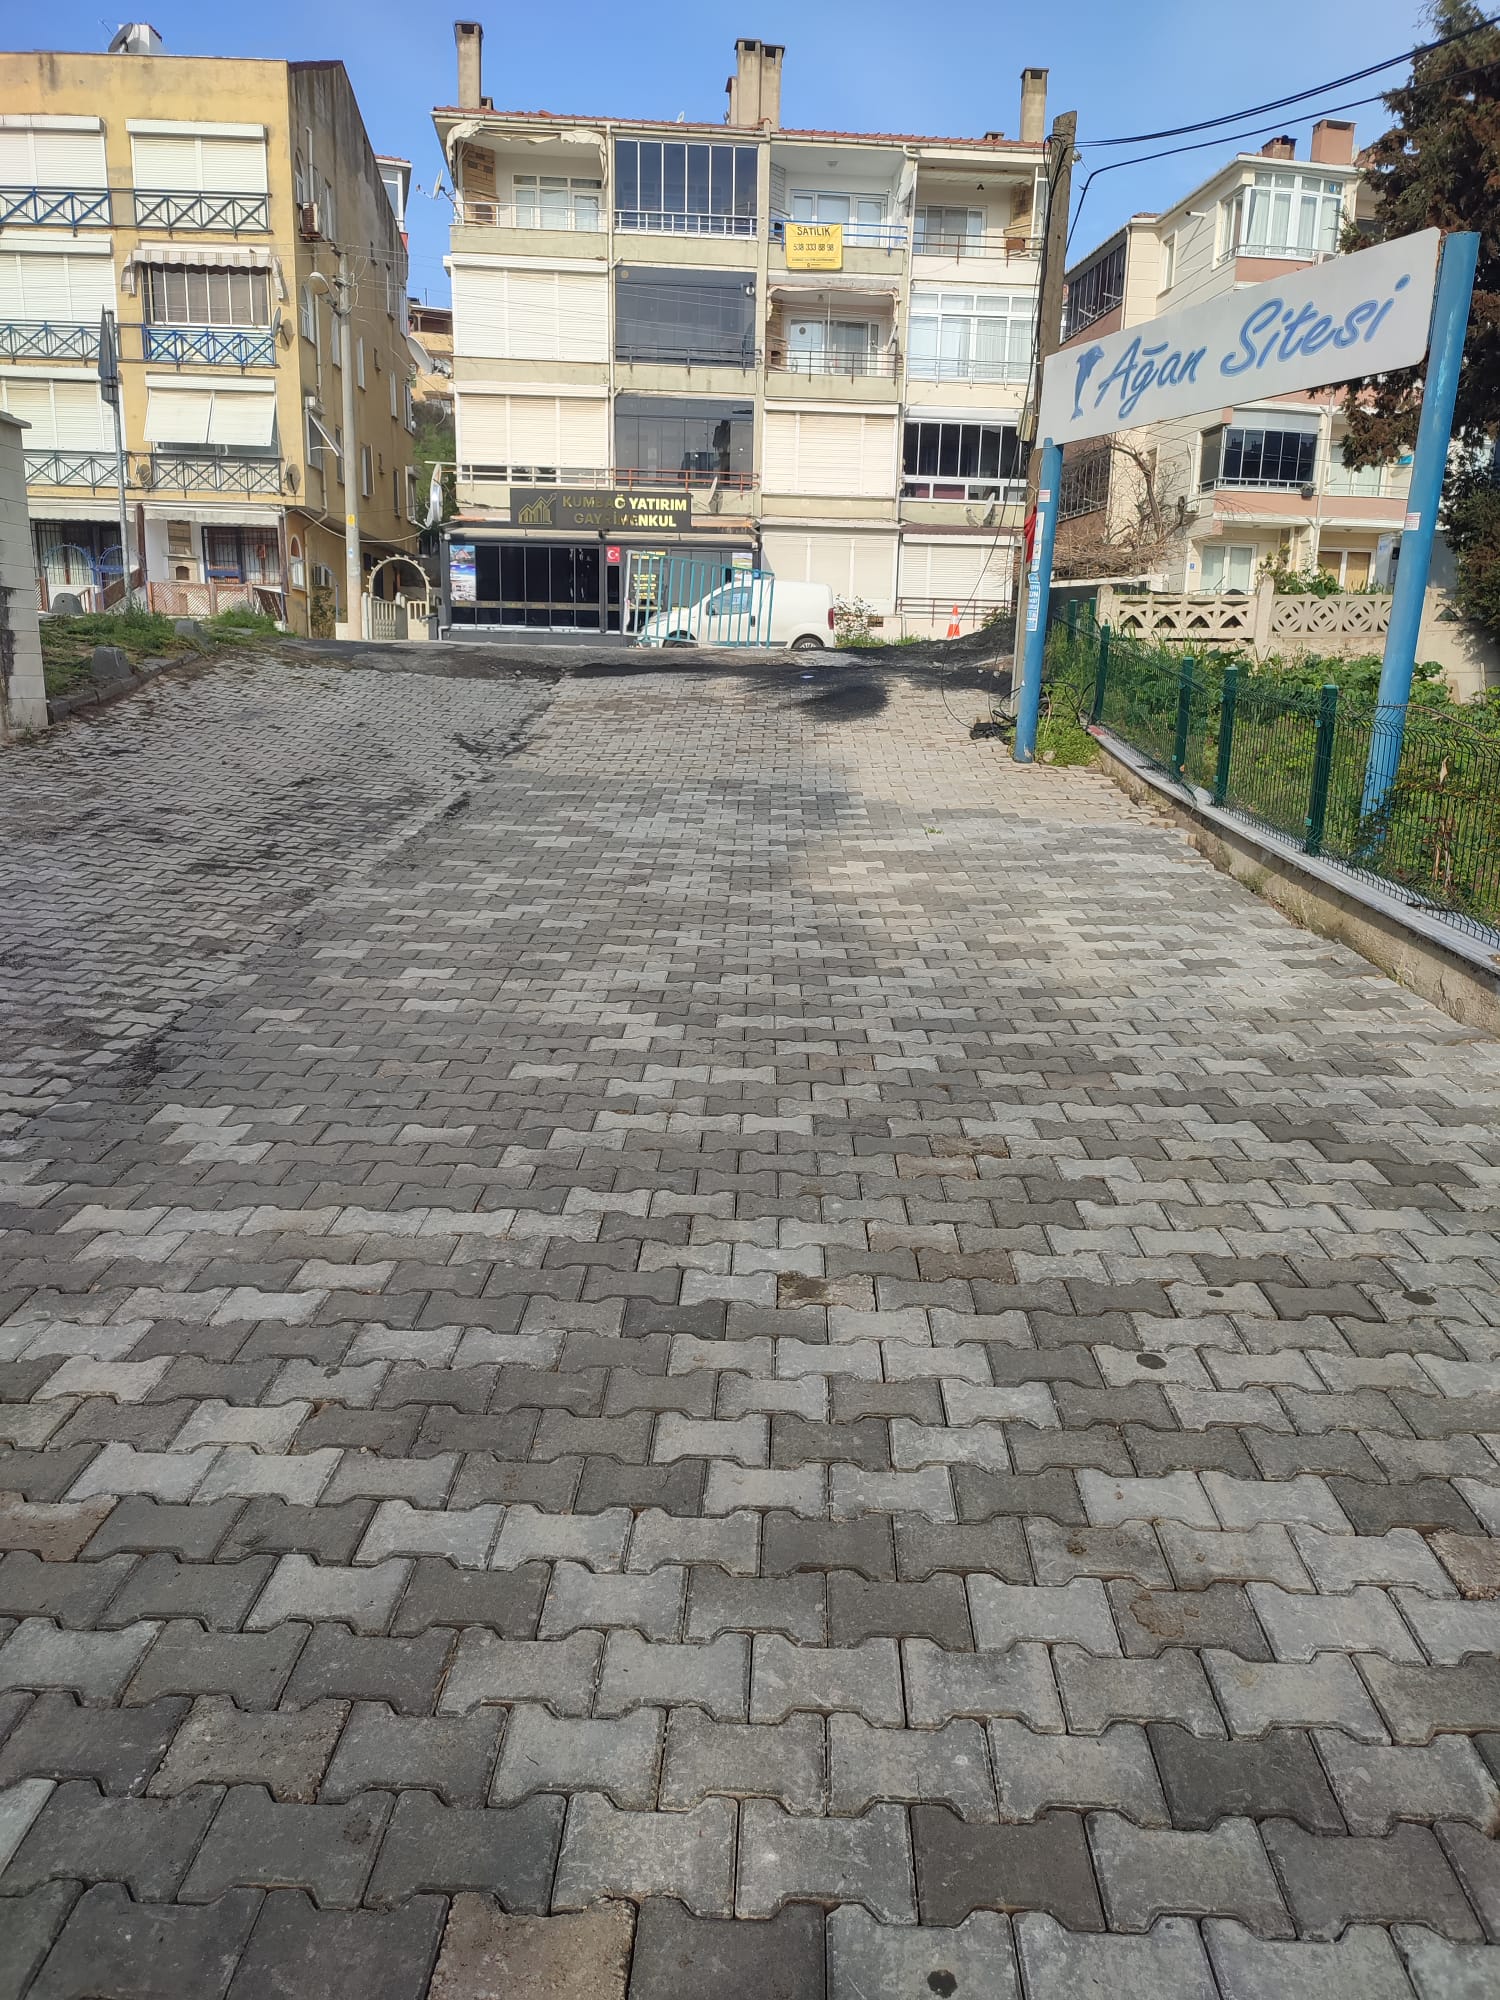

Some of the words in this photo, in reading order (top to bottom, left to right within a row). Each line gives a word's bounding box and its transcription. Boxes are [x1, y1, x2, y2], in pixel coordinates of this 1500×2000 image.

[797, 226, 831, 237] SATILIK
[1094, 336, 1207, 420] Ağan
[1221, 273, 1411, 377] Sitesi
[562, 494, 625, 510] KUMBAĞ
[629, 498, 687, 512] YATIRIM
